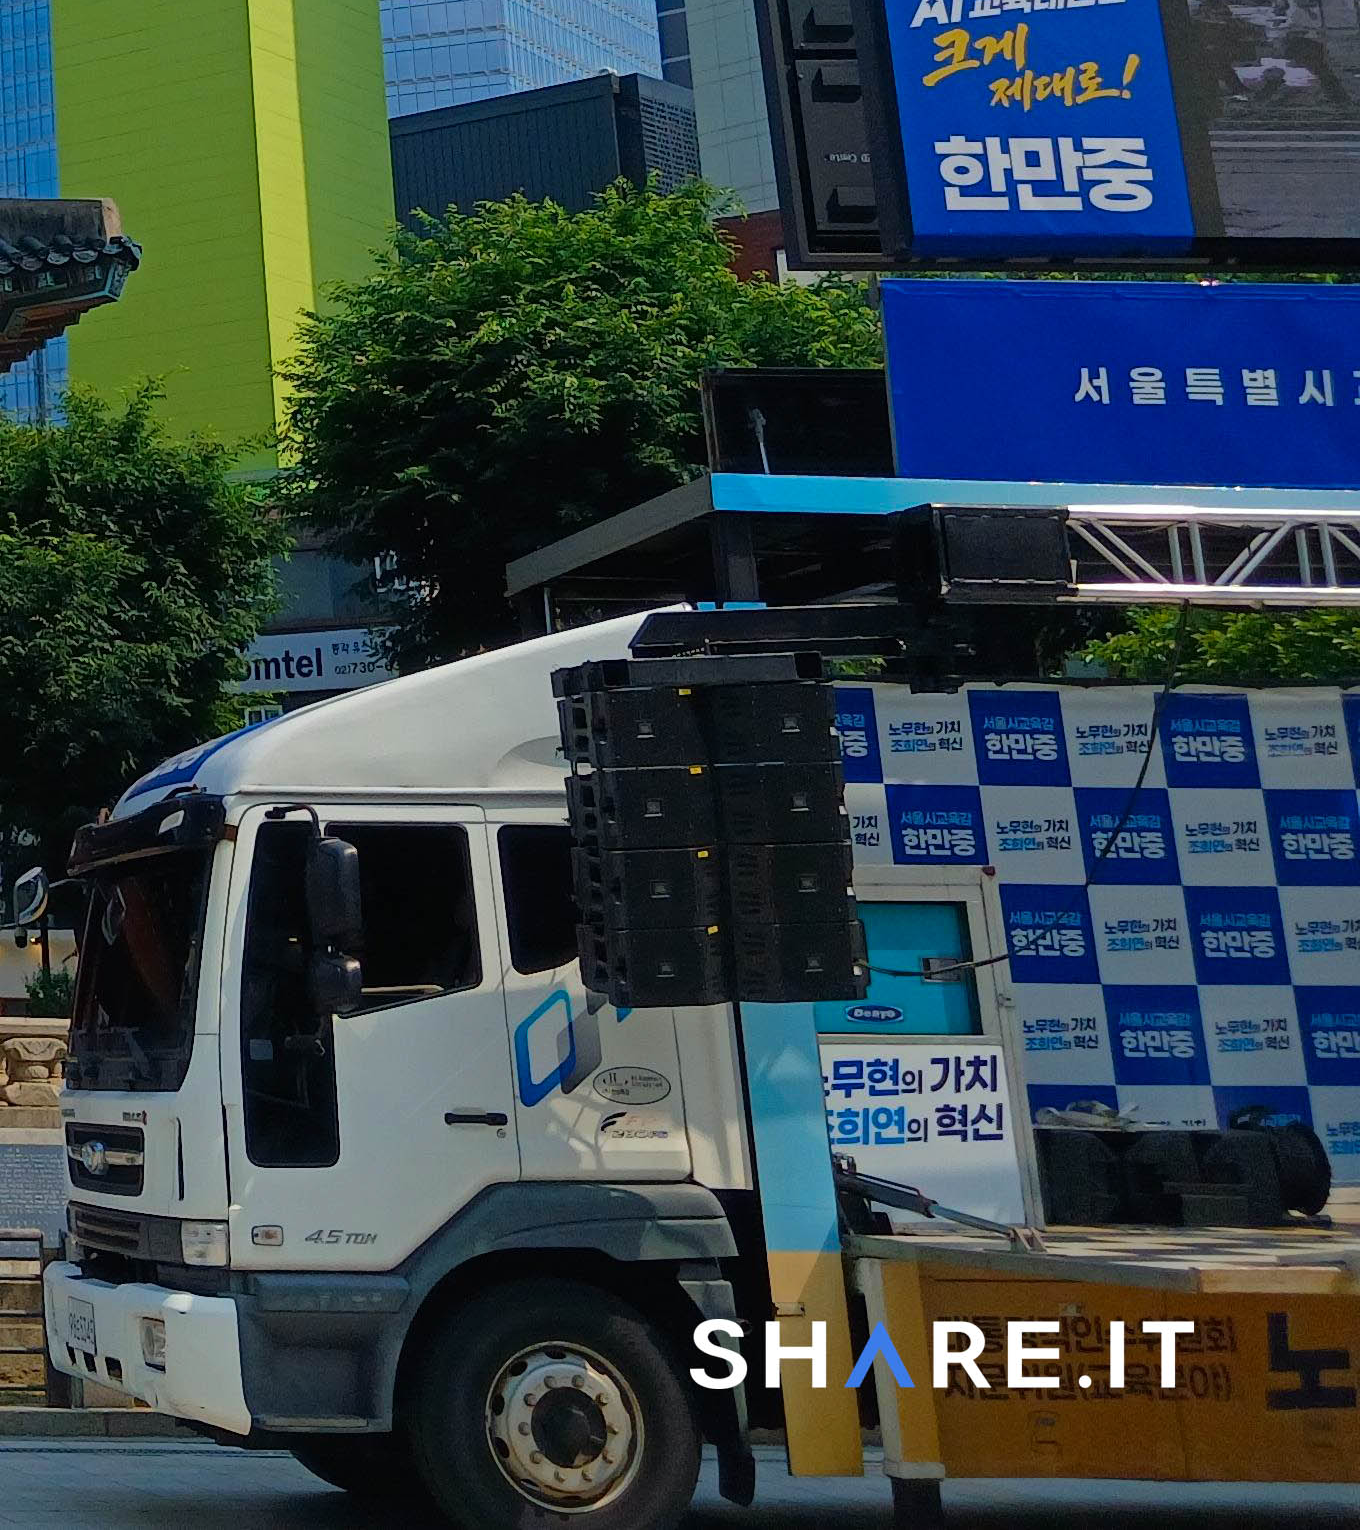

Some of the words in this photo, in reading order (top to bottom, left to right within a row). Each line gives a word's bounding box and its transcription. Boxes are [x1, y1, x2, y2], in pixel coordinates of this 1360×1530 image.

[922, 22, 1029, 87] 크게
[988, 53, 1140, 113] 제대로!
[933, 135, 1154, 213] 한만중
[935, 720, 961, 735] 가치
[1123, 723, 1148, 737] 가치
[938, 737, 963, 751] 혁신
[984, 732, 1058, 761] 한만중
[1126, 740, 1152, 755] 혁신
[1171, 735, 1245, 763] 한만중
[852, 815, 878, 830] 가치
[1044, 819, 1069, 834] 가치
[1232, 821, 1257, 835] 가치
[854, 833, 880, 847] 혁신
[901, 827, 976, 857] 한만중
[1046, 836, 1072, 851] 혁신
[1091, 830, 1166, 860] 한만중
[1235, 838, 1261, 853] 혁신
[1281, 832, 1356, 861] 한만중
[1152, 918, 1177, 933] 가치
[1010, 928, 1086, 957] 한만중
[1154, 936, 1180, 950] 혁신
[1200, 930, 1276, 959] 한만중
[1070, 1017, 1096, 1033] 가치
[1073, 1034, 1099, 1050] 혁신
[1119, 1029, 1196, 1059] 한만중
[1311, 1030, 1360, 1059] 한만
[822, 1057, 923, 1098] 무현의
[930, 1054, 998, 1094] 가치
[934, 1102, 1004, 1142] 혁신
[345, 1233, 378, 1245] TON
[1265, 1311, 1357, 1410] 노
